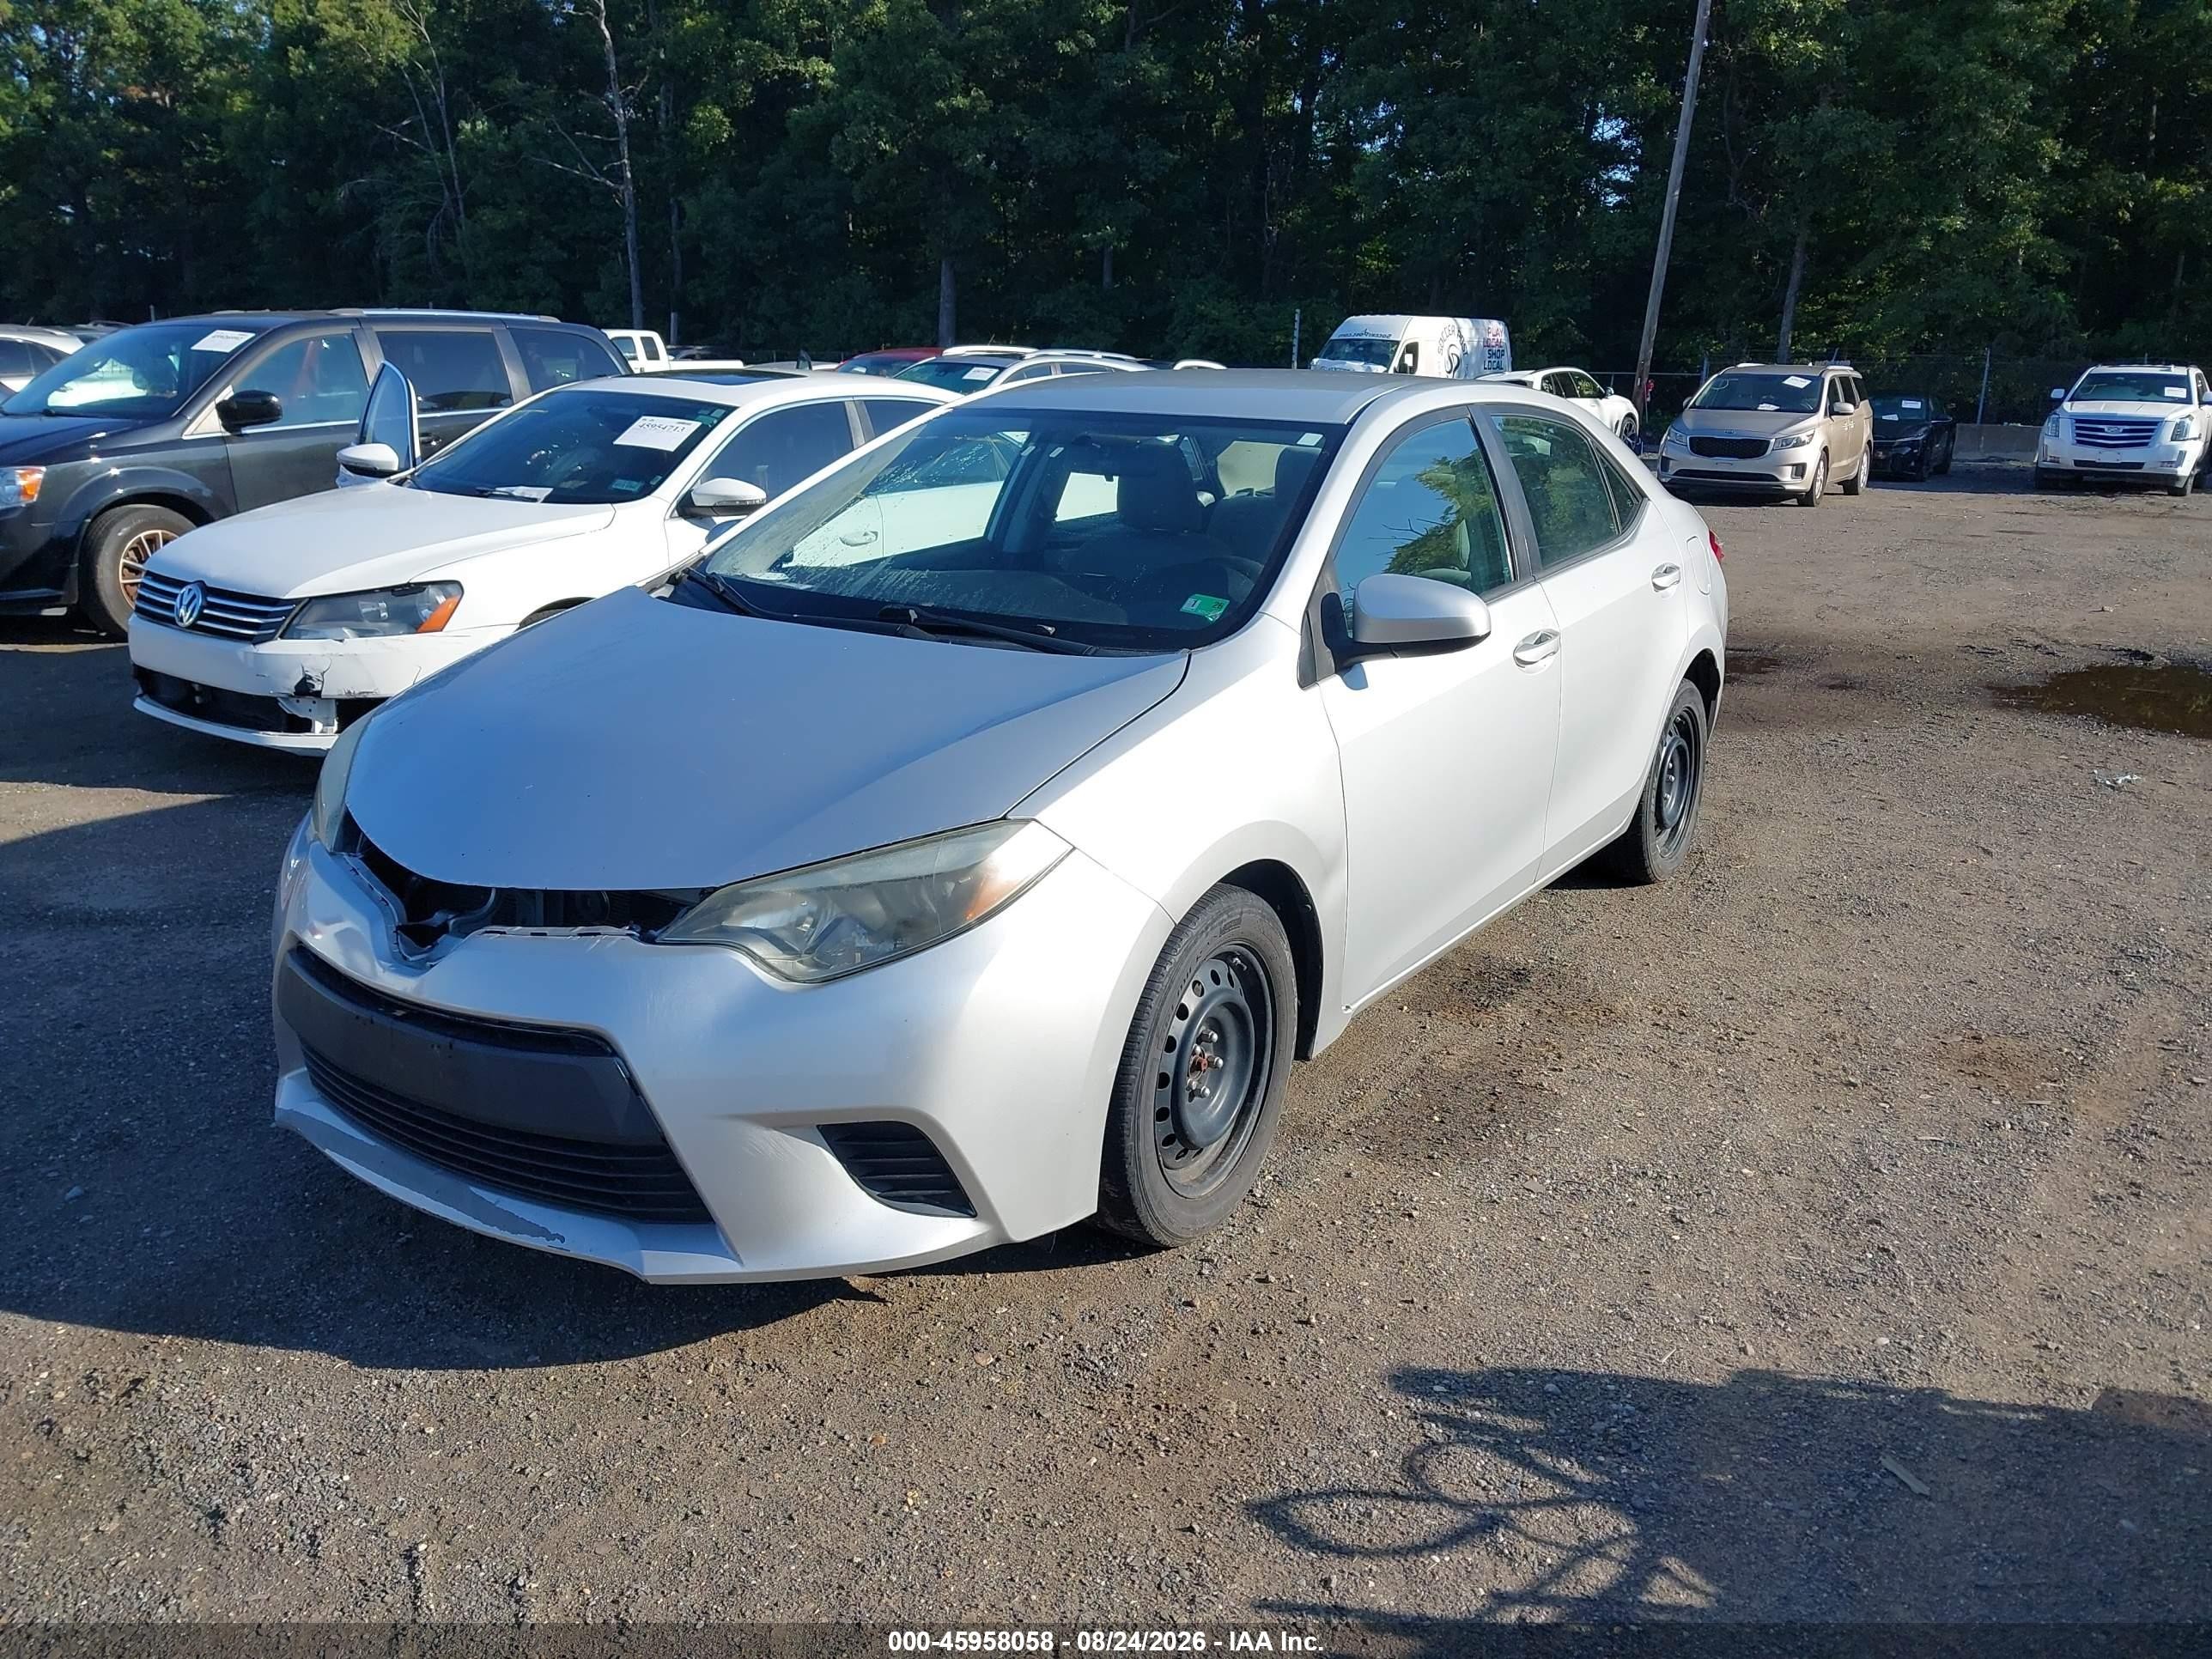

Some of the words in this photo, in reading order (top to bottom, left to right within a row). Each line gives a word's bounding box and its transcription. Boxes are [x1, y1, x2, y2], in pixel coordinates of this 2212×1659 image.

[1487, 327, 1504, 337] PLAY
[1438, 325, 1455, 356] SOCCER
[1457, 330, 1469, 356] POST
[1483, 338, 1503, 348] LOCAL
[1487, 349, 1504, 358] SHOP
[1484, 360, 1504, 370] LOCAL
